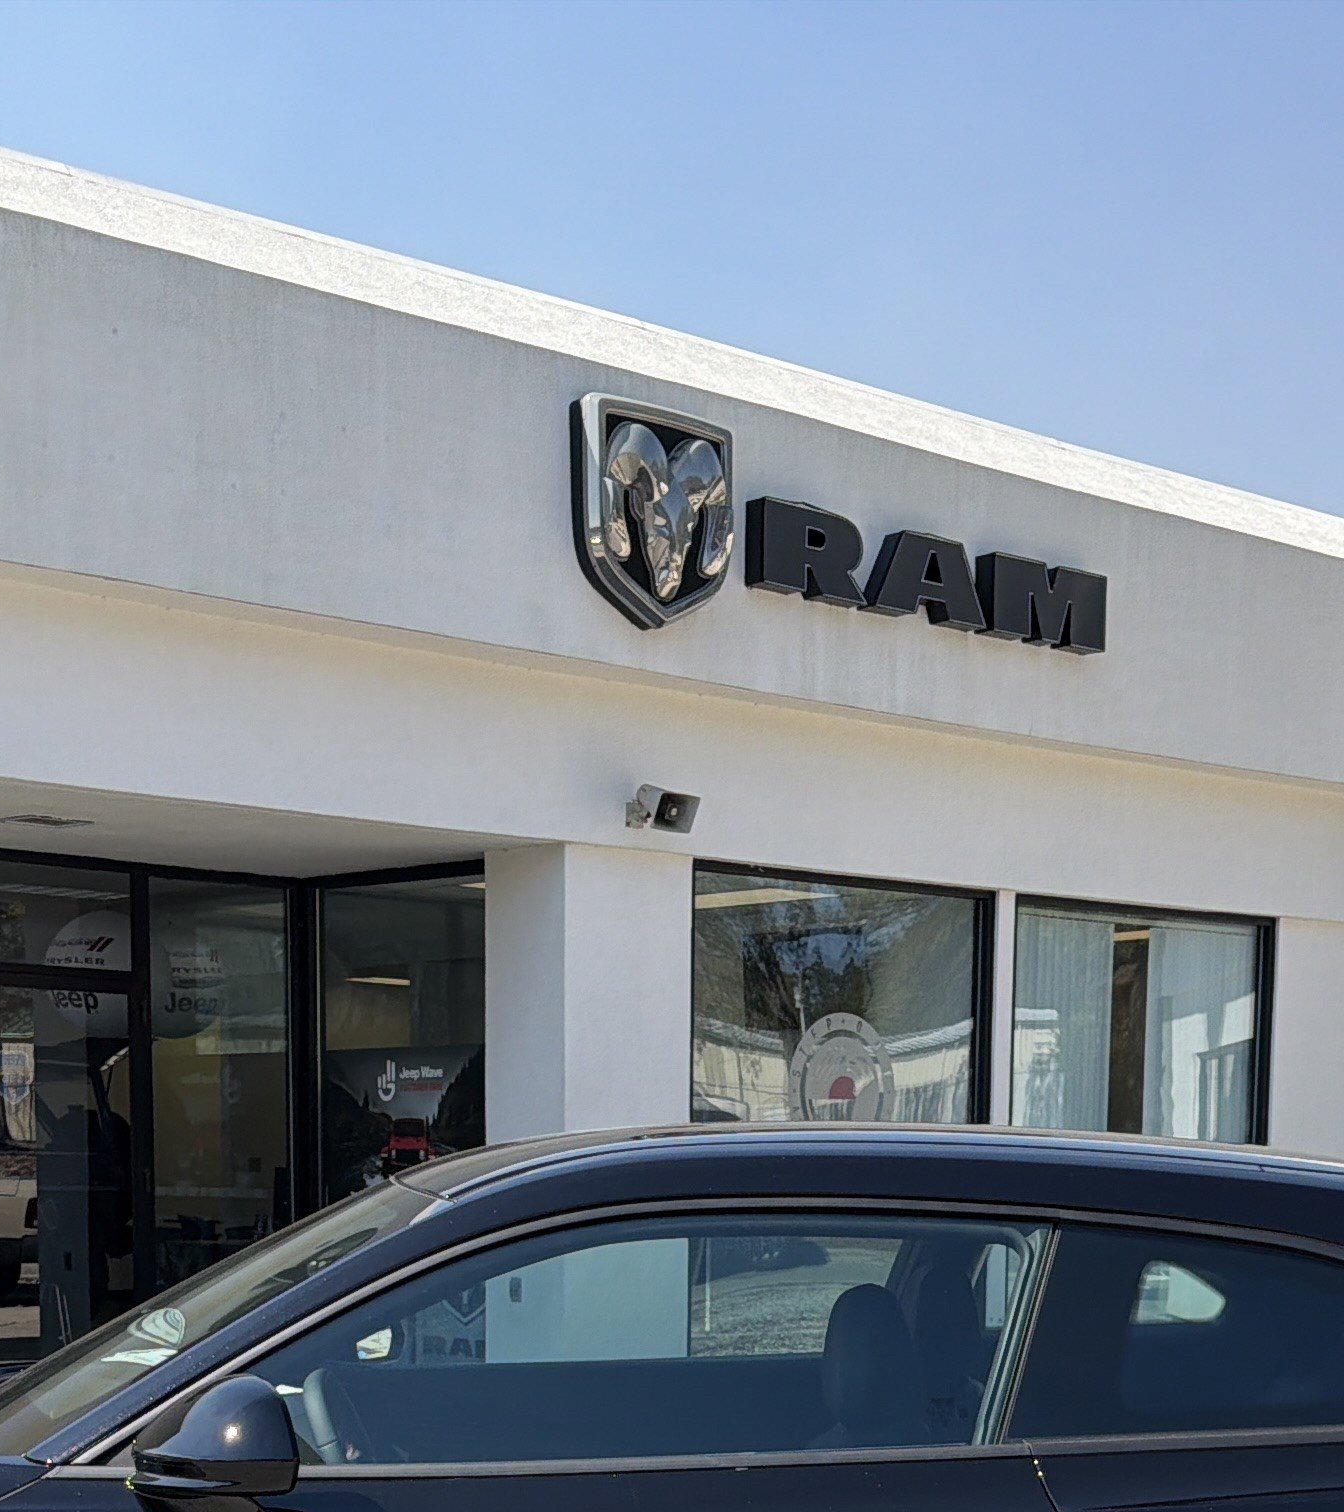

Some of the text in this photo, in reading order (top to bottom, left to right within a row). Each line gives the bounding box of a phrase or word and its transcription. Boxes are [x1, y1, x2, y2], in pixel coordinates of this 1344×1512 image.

[745, 496, 1107, 655] RAM
[399, 1066, 443, 1080] Jeep Wave
